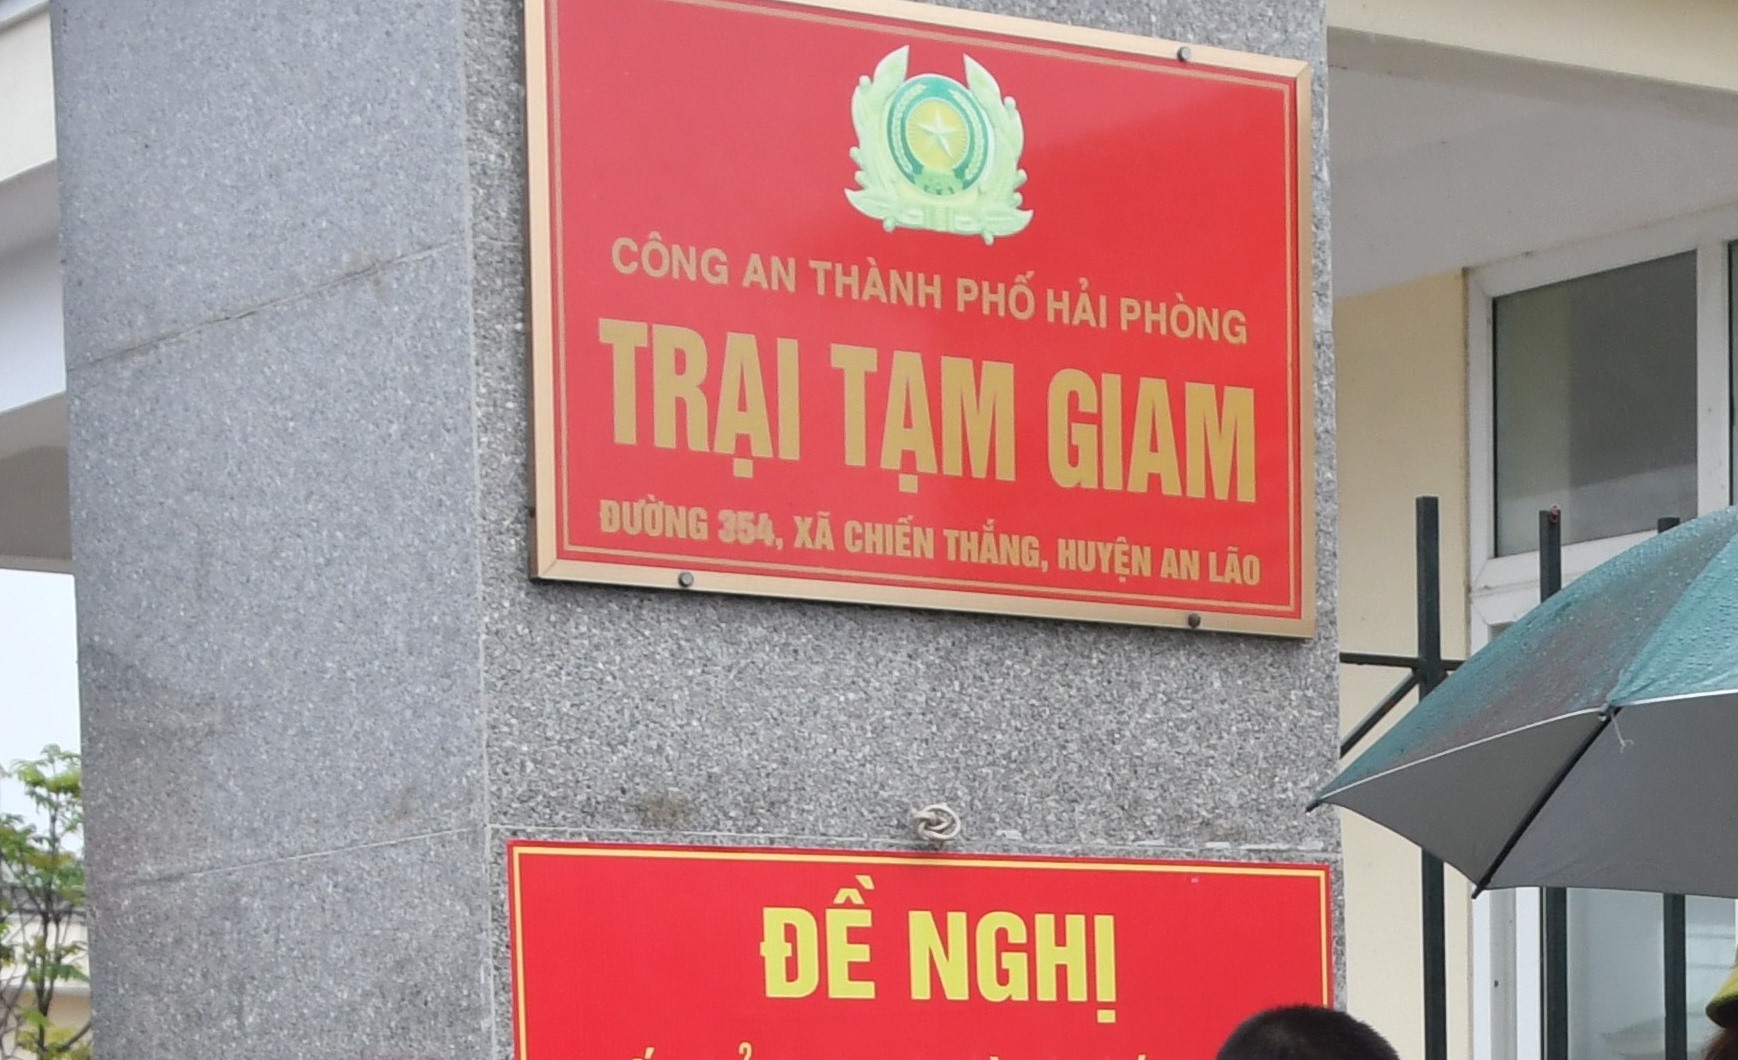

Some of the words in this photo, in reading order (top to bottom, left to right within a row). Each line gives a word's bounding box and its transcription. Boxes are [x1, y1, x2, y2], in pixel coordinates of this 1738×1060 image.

[612, 232, 728, 286] CÔNG
[743, 254, 796, 292] AN
[810, 256, 942, 309] THÀNH
[956, 270, 1035, 319] PHỐ
[1046, 279, 1106, 329] HẢI
[1120, 297, 1248, 343] PHÒNG
[598, 319, 799, 477] TRẠI
[830, 343, 1015, 493] TẠM
[1046, 369, 1256, 503] GIAM
[599, 495, 708, 541] ĐƯỜNG
[718, 508, 783, 550] 354,
[793, 510, 835, 550] XÃ
[843, 512, 934, 559] CHIẾN
[944, 519, 1048, 572] THẮNG,
[1058, 537, 1151, 583] HUYỆN
[1160, 548, 1199, 580] AN
[1209, 546, 1260, 586] LÃO
[759, 874, 877, 1000] ĐỀ
[908, 909, 1118, 1024] NGHỊ
